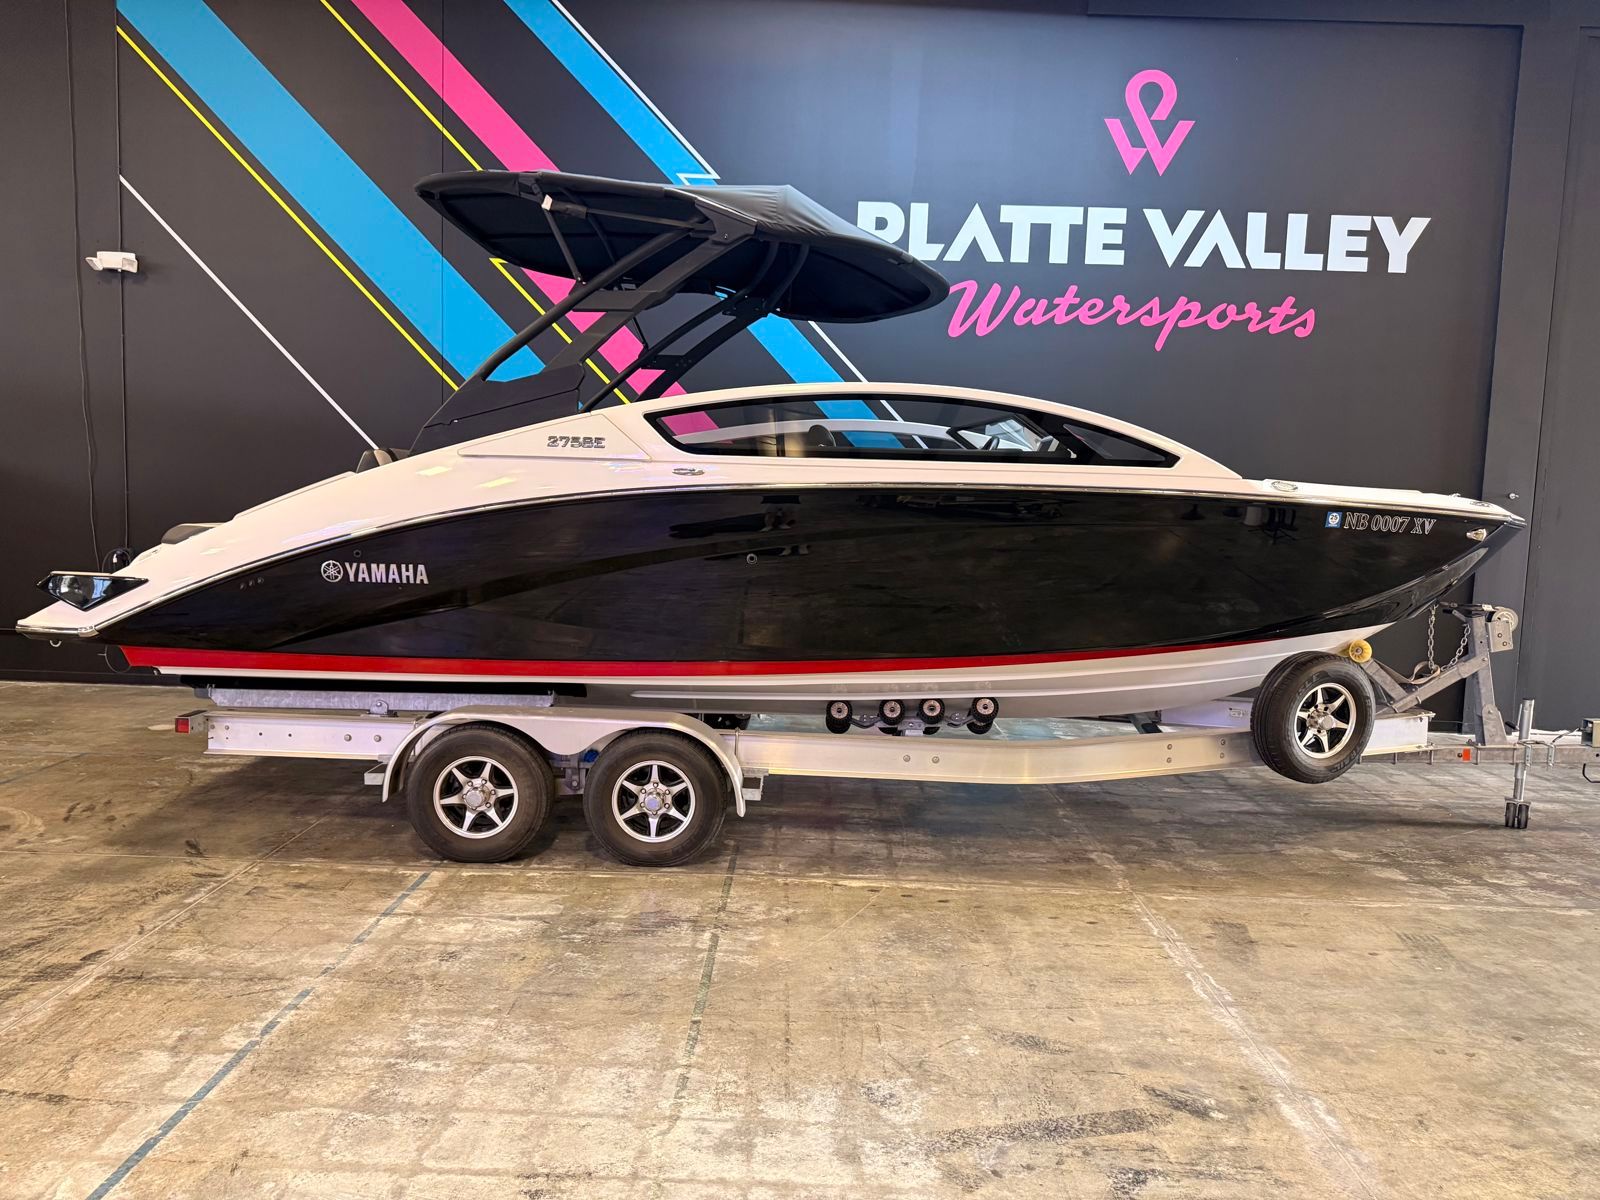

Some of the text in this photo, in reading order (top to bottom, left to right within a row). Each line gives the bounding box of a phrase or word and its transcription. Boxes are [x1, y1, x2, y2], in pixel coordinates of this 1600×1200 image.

[856, 200, 1432, 274] PLATTE VALLEY
[948, 279, 1316, 352] Watersports
[1343, 511, 1437, 535] NB 0007 XV
[344, 562, 429, 585] YAMAHA
